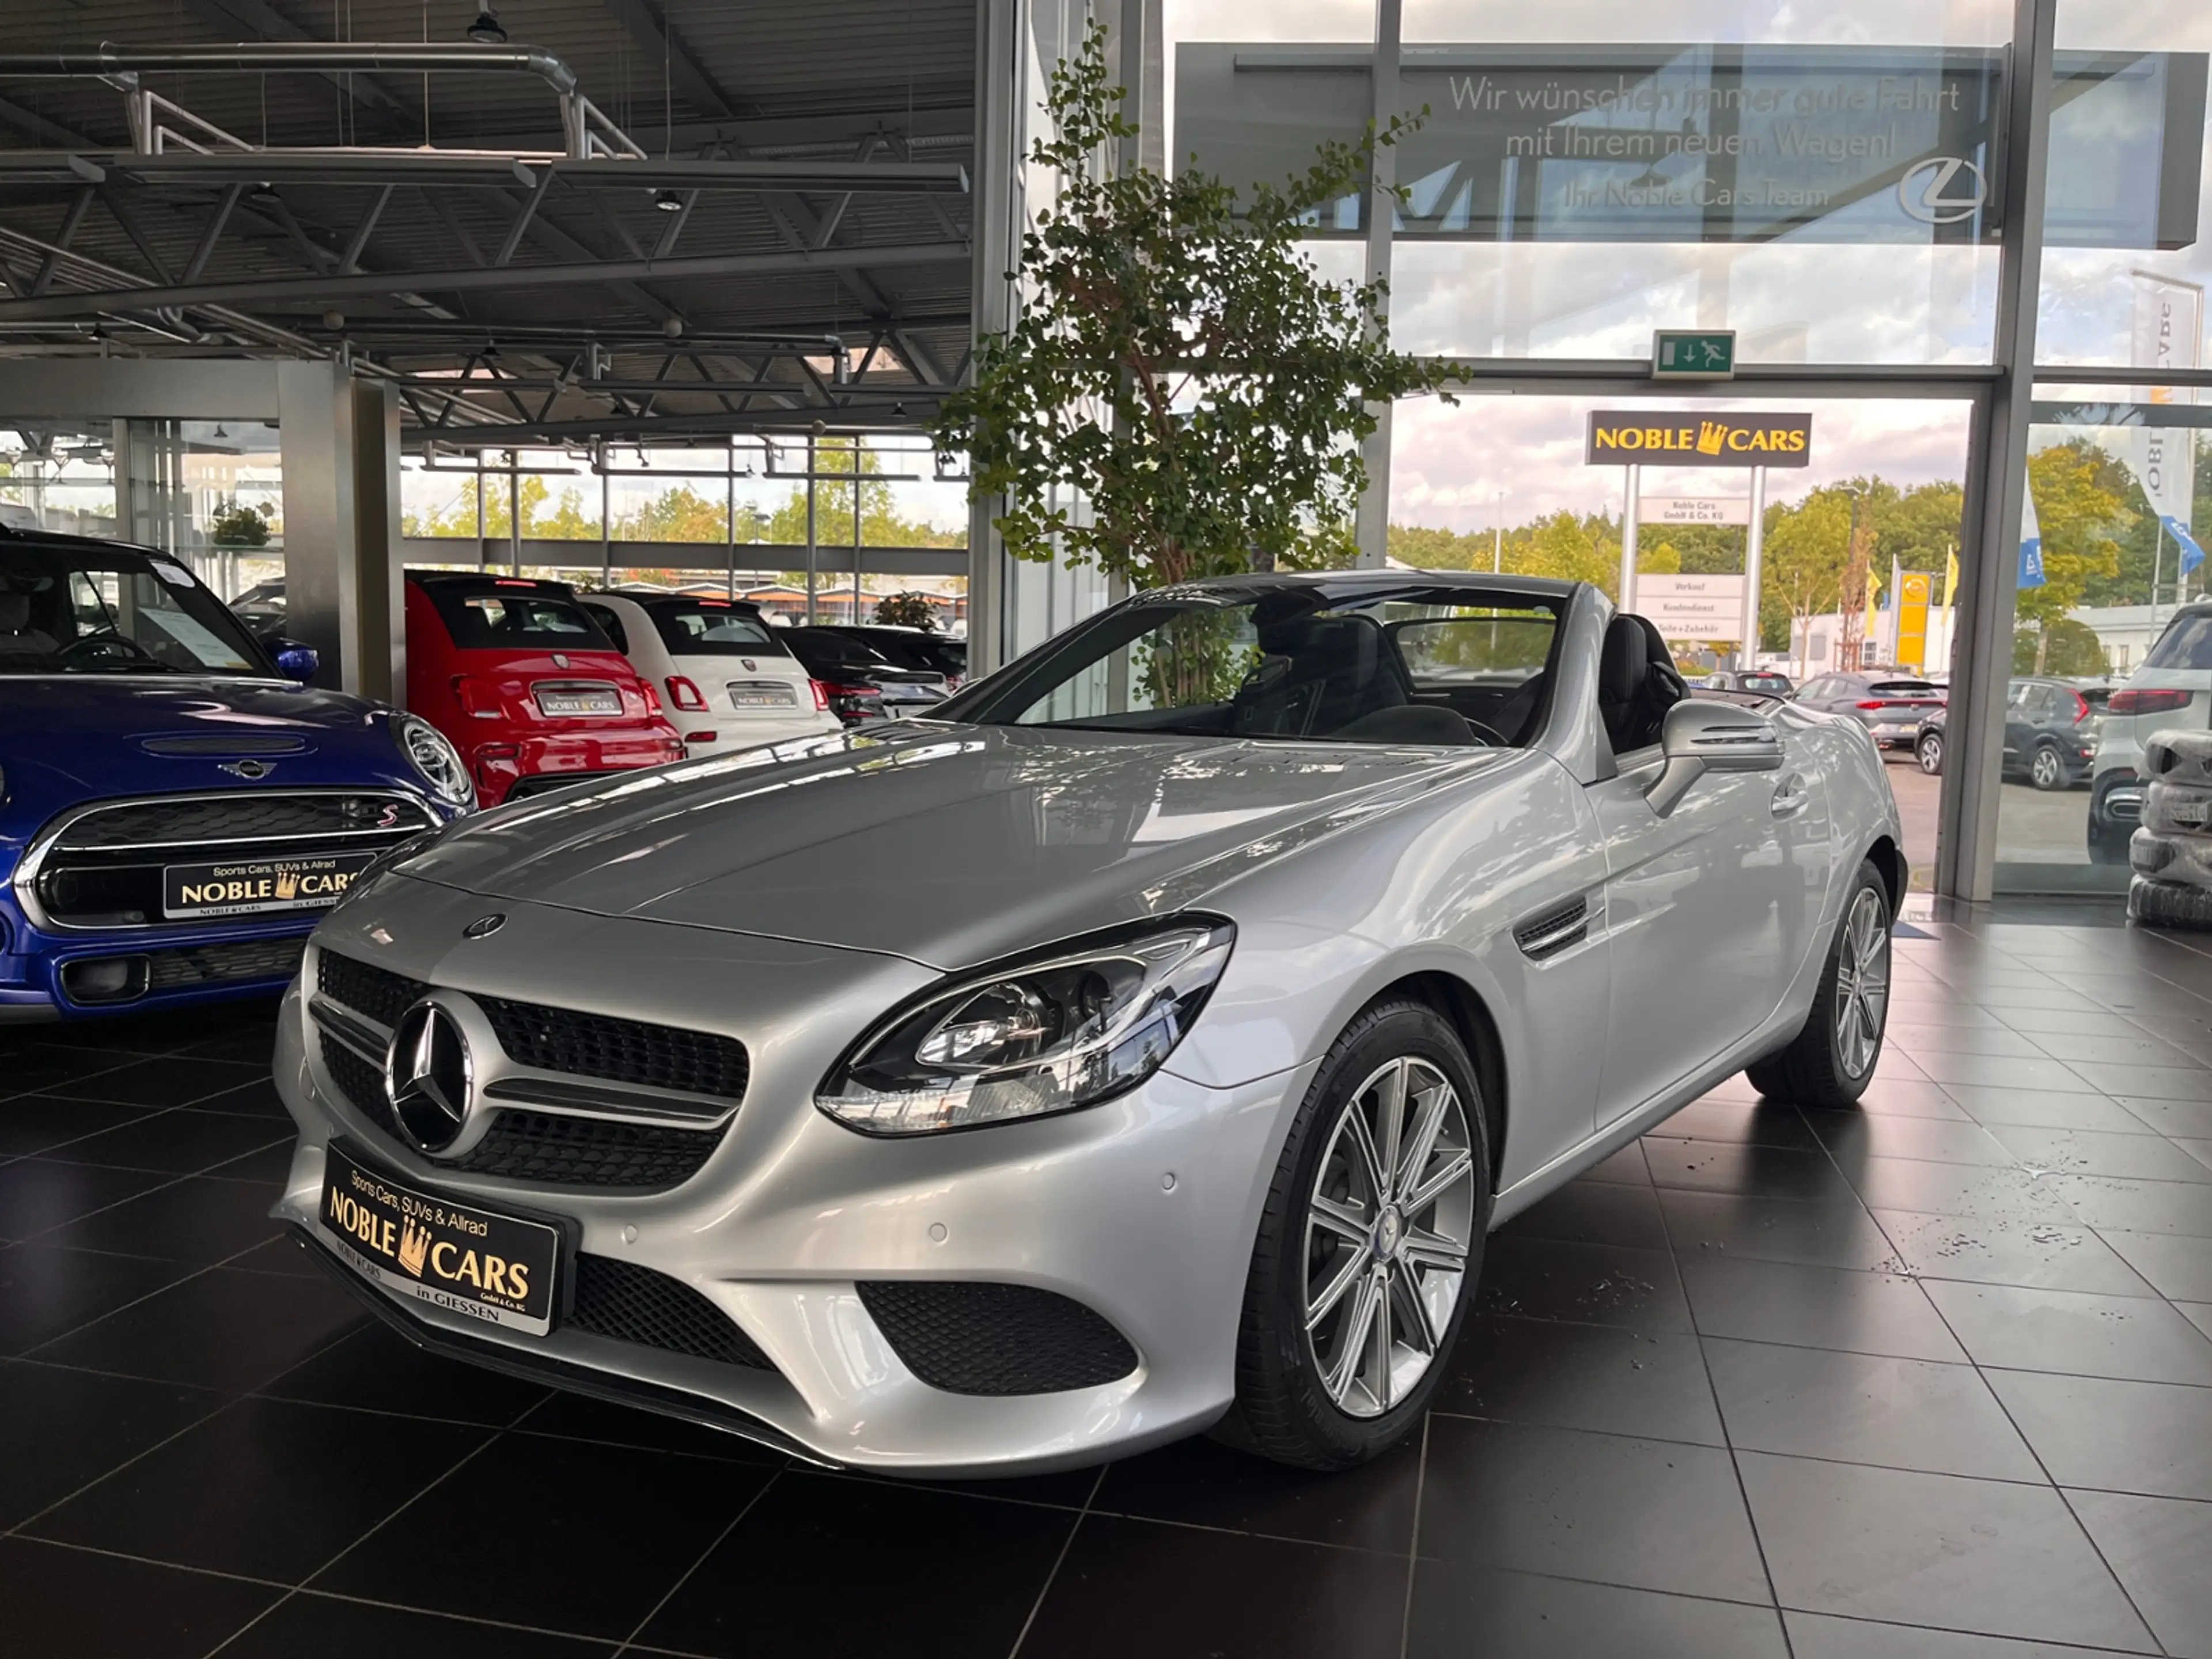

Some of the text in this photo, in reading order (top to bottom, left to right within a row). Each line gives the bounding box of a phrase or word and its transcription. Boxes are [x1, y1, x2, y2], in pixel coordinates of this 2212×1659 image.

[1449, 75, 1959, 118] Wir wünschen immer gute Fahrt
[1506, 127, 1554, 156] mit
[1564, 122, 1655, 156] Ihrem
[1665, 131, 1762, 156] neuen
[1564, 178, 1830, 209] Ihr Noble Cars Team
[1595, 428, 1805, 452] NOBLE CARS
[1664, 511, 1687, 520] GmbH
[1688, 512, 1695, 520] &
[1672, 501, 1715, 510] Noble Cars
[1675, 582, 1706, 591] Verkauf
[1662, 603, 1714, 612] Kundendienst
[547, 701, 615, 710] NOBLE CARS
[213, 866, 247, 877] Sports
[275, 862, 301, 873] SUVs
[302, 861, 309, 870] &
[181, 879, 271, 904] NOBLE
[200, 907, 229, 915] NOBLE
[351, 1169, 488, 1237] Sports Cars, SUVs & Allrad
[330, 1185, 529, 1300] NOBLE CARS
[416, 1286, 499, 1321] in GIESSEN
